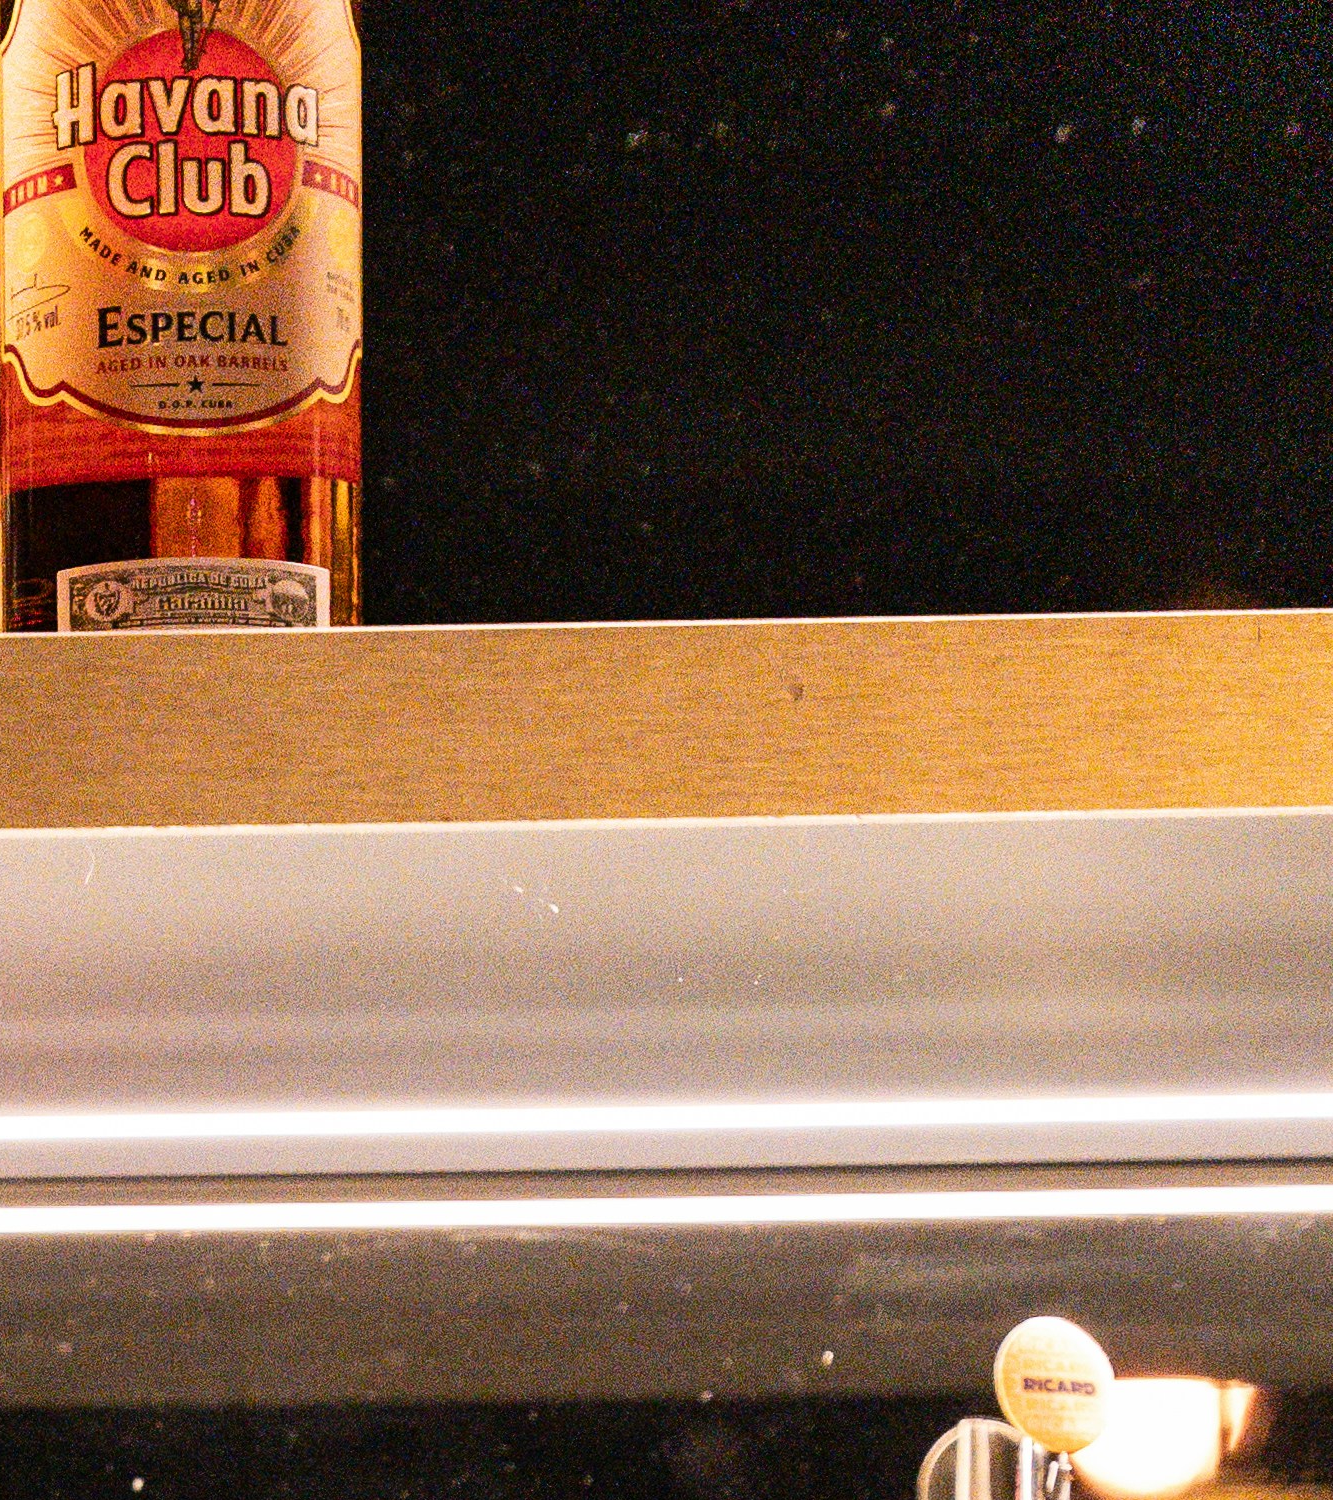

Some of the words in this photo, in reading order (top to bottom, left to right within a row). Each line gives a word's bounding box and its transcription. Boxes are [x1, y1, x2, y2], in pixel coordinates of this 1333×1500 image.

[51, 62, 319, 150] Havana
[106, 139, 271, 219] Club
[96, 306, 289, 349] ESPECIAL
[1023, 1376, 1096, 1397] RICARD
